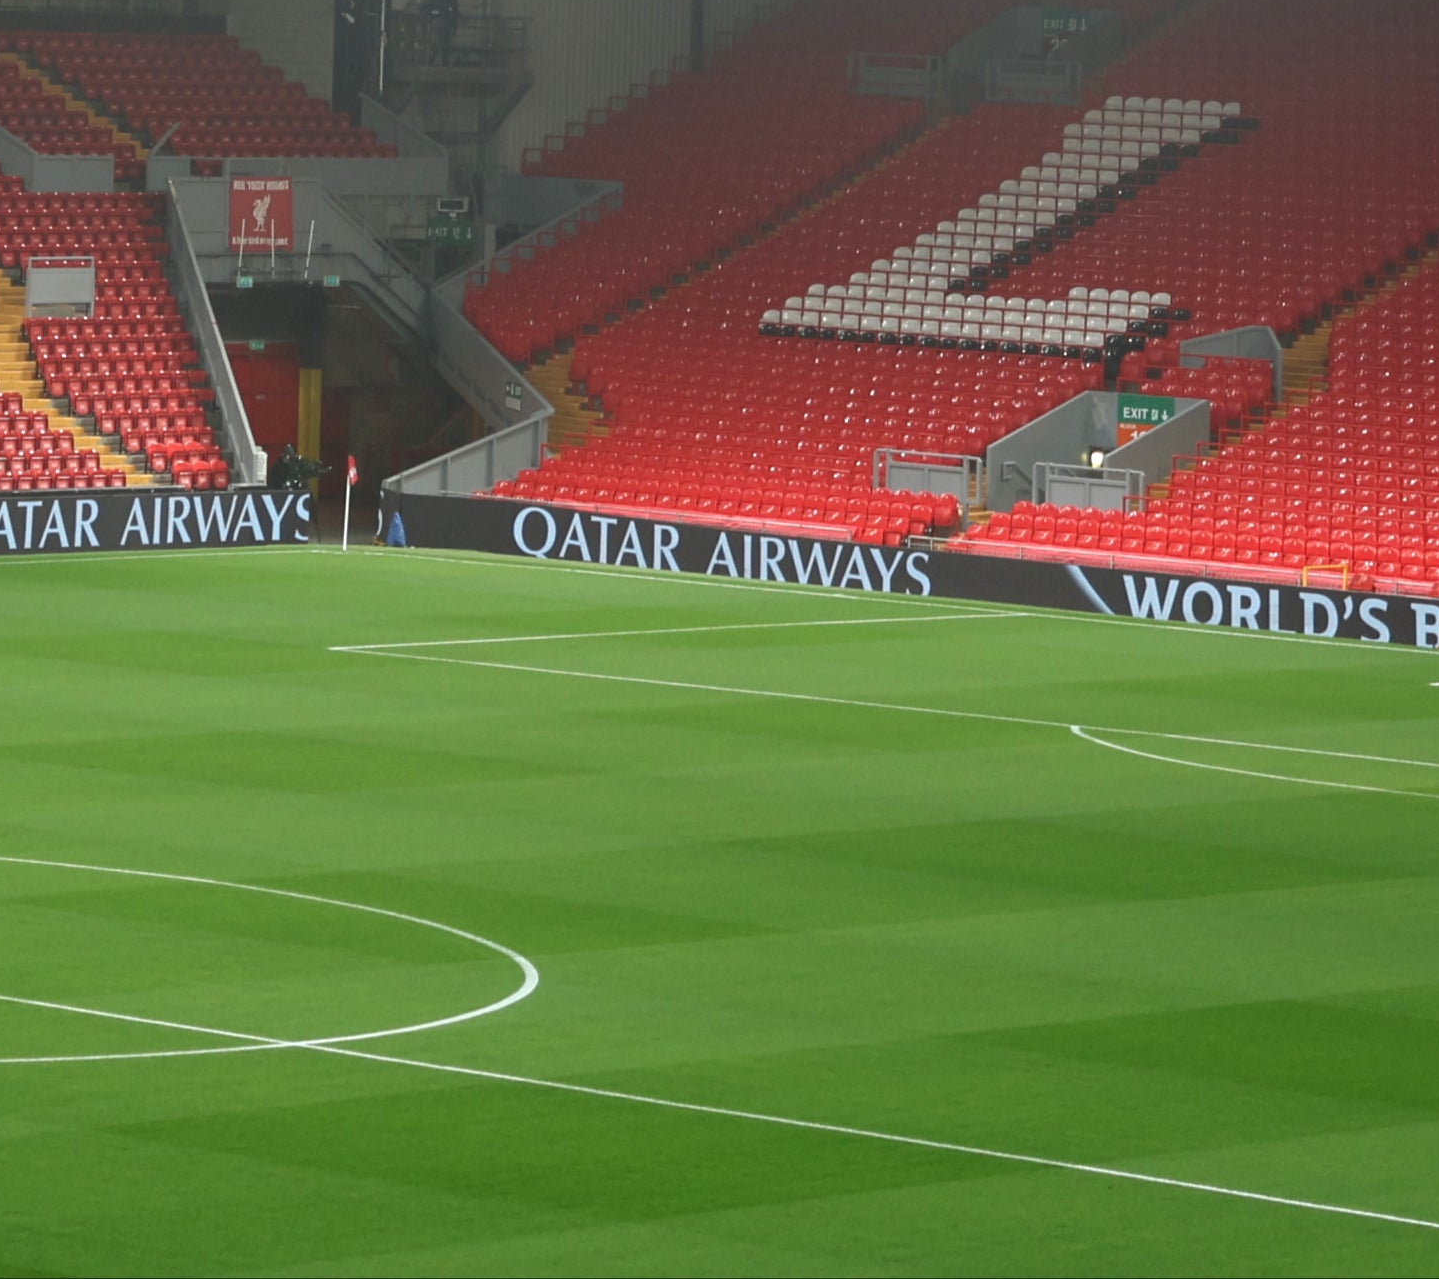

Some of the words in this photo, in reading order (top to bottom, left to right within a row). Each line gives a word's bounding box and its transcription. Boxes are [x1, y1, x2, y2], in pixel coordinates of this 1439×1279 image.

[1043, 19, 1064, 29] EXIT
[1123, 406, 1149, 419] EXIT
[121, 493, 311, 546] AIRWAYS
[512, 506, 682, 572] QATAR
[707, 531, 931, 596] AIRWAYS
[1124, 574, 1391, 643] WORLD'S
